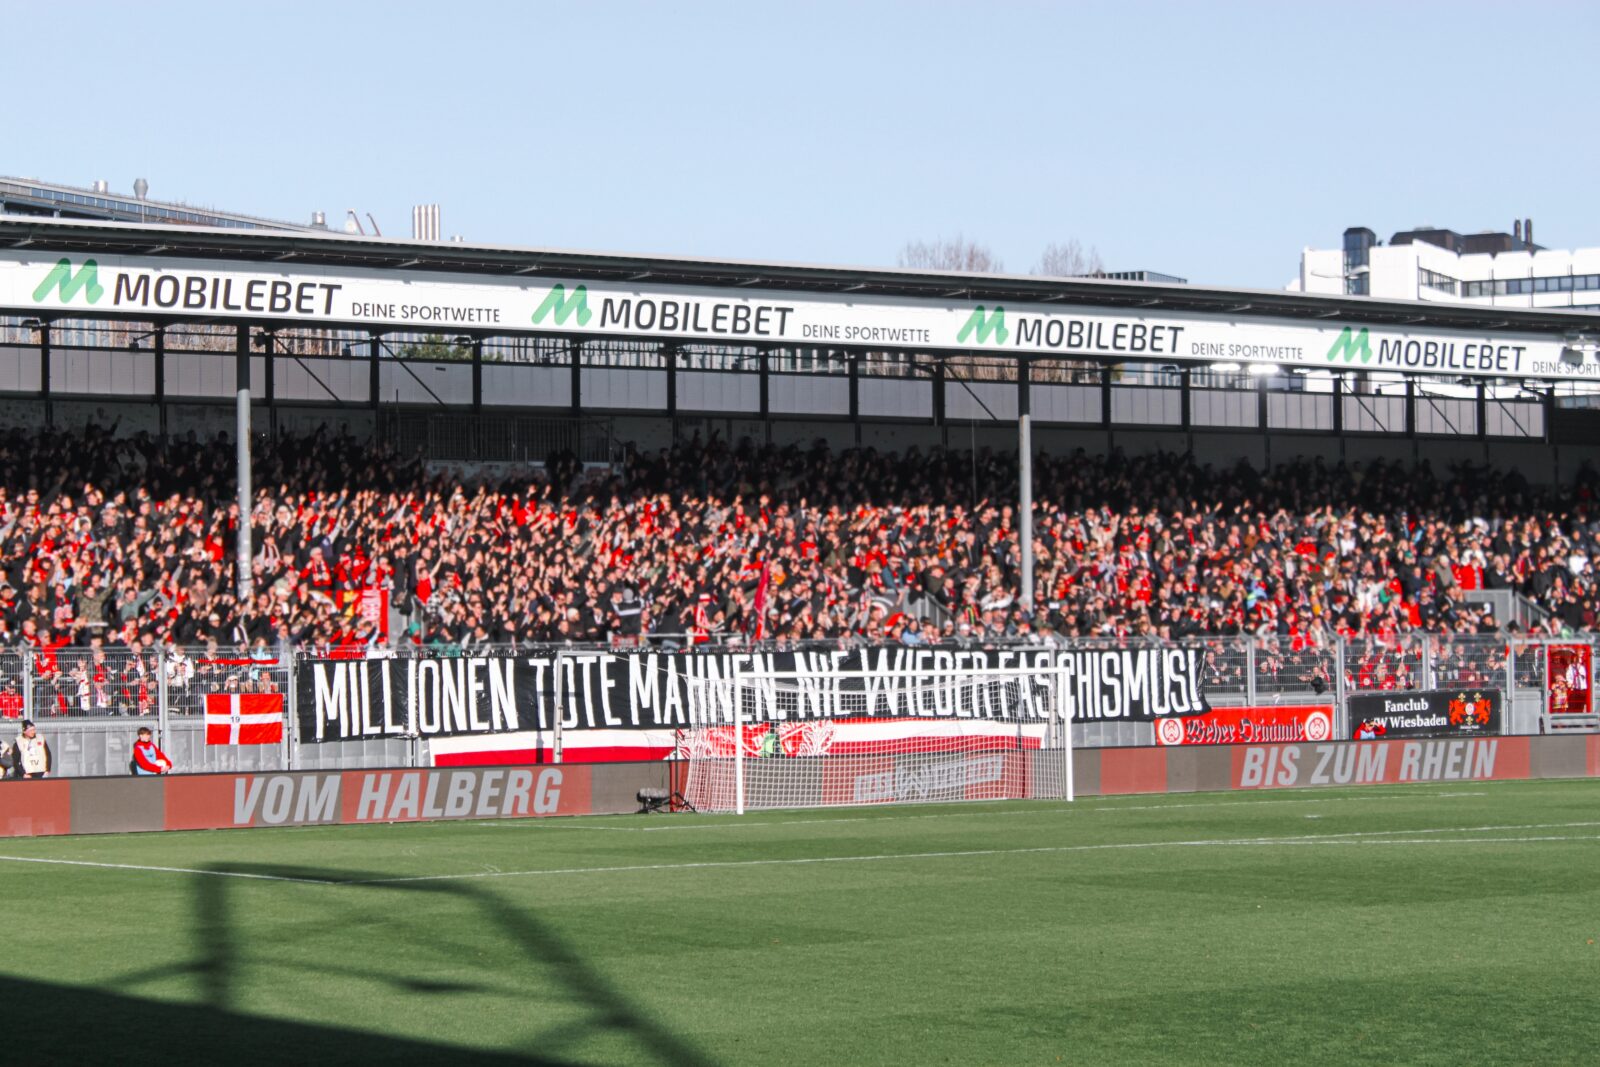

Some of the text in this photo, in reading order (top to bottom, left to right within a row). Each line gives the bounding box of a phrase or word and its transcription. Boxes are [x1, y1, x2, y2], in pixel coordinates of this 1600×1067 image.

[113, 272, 500, 323] MOBILEBET DEINE SPORTWETTE
[600, 298, 930, 343] MOBILEBET DEINE SPORTWETTE
[1016, 318, 1303, 359] MOBILEBET DEINE SPORTWETTE
[1378, 338, 1526, 371] MOBILEBET
[1532, 361, 1561, 374] DEINE
[313, 656, 519, 739] MILLIONEN
[529, 655, 623, 730] TOTE
[794, 651, 849, 718] NIE
[860, 649, 993, 718] WIEDER
[998, 649, 1203, 720] FASCHISMUS!
[1384, 698, 1429, 712] Fanclub
[1389, 713, 1447, 729] Wiesbaden
[1240, 739, 1498, 787] BIS ZUM RHEIN
[233, 768, 563, 825] VOM HALBERG
